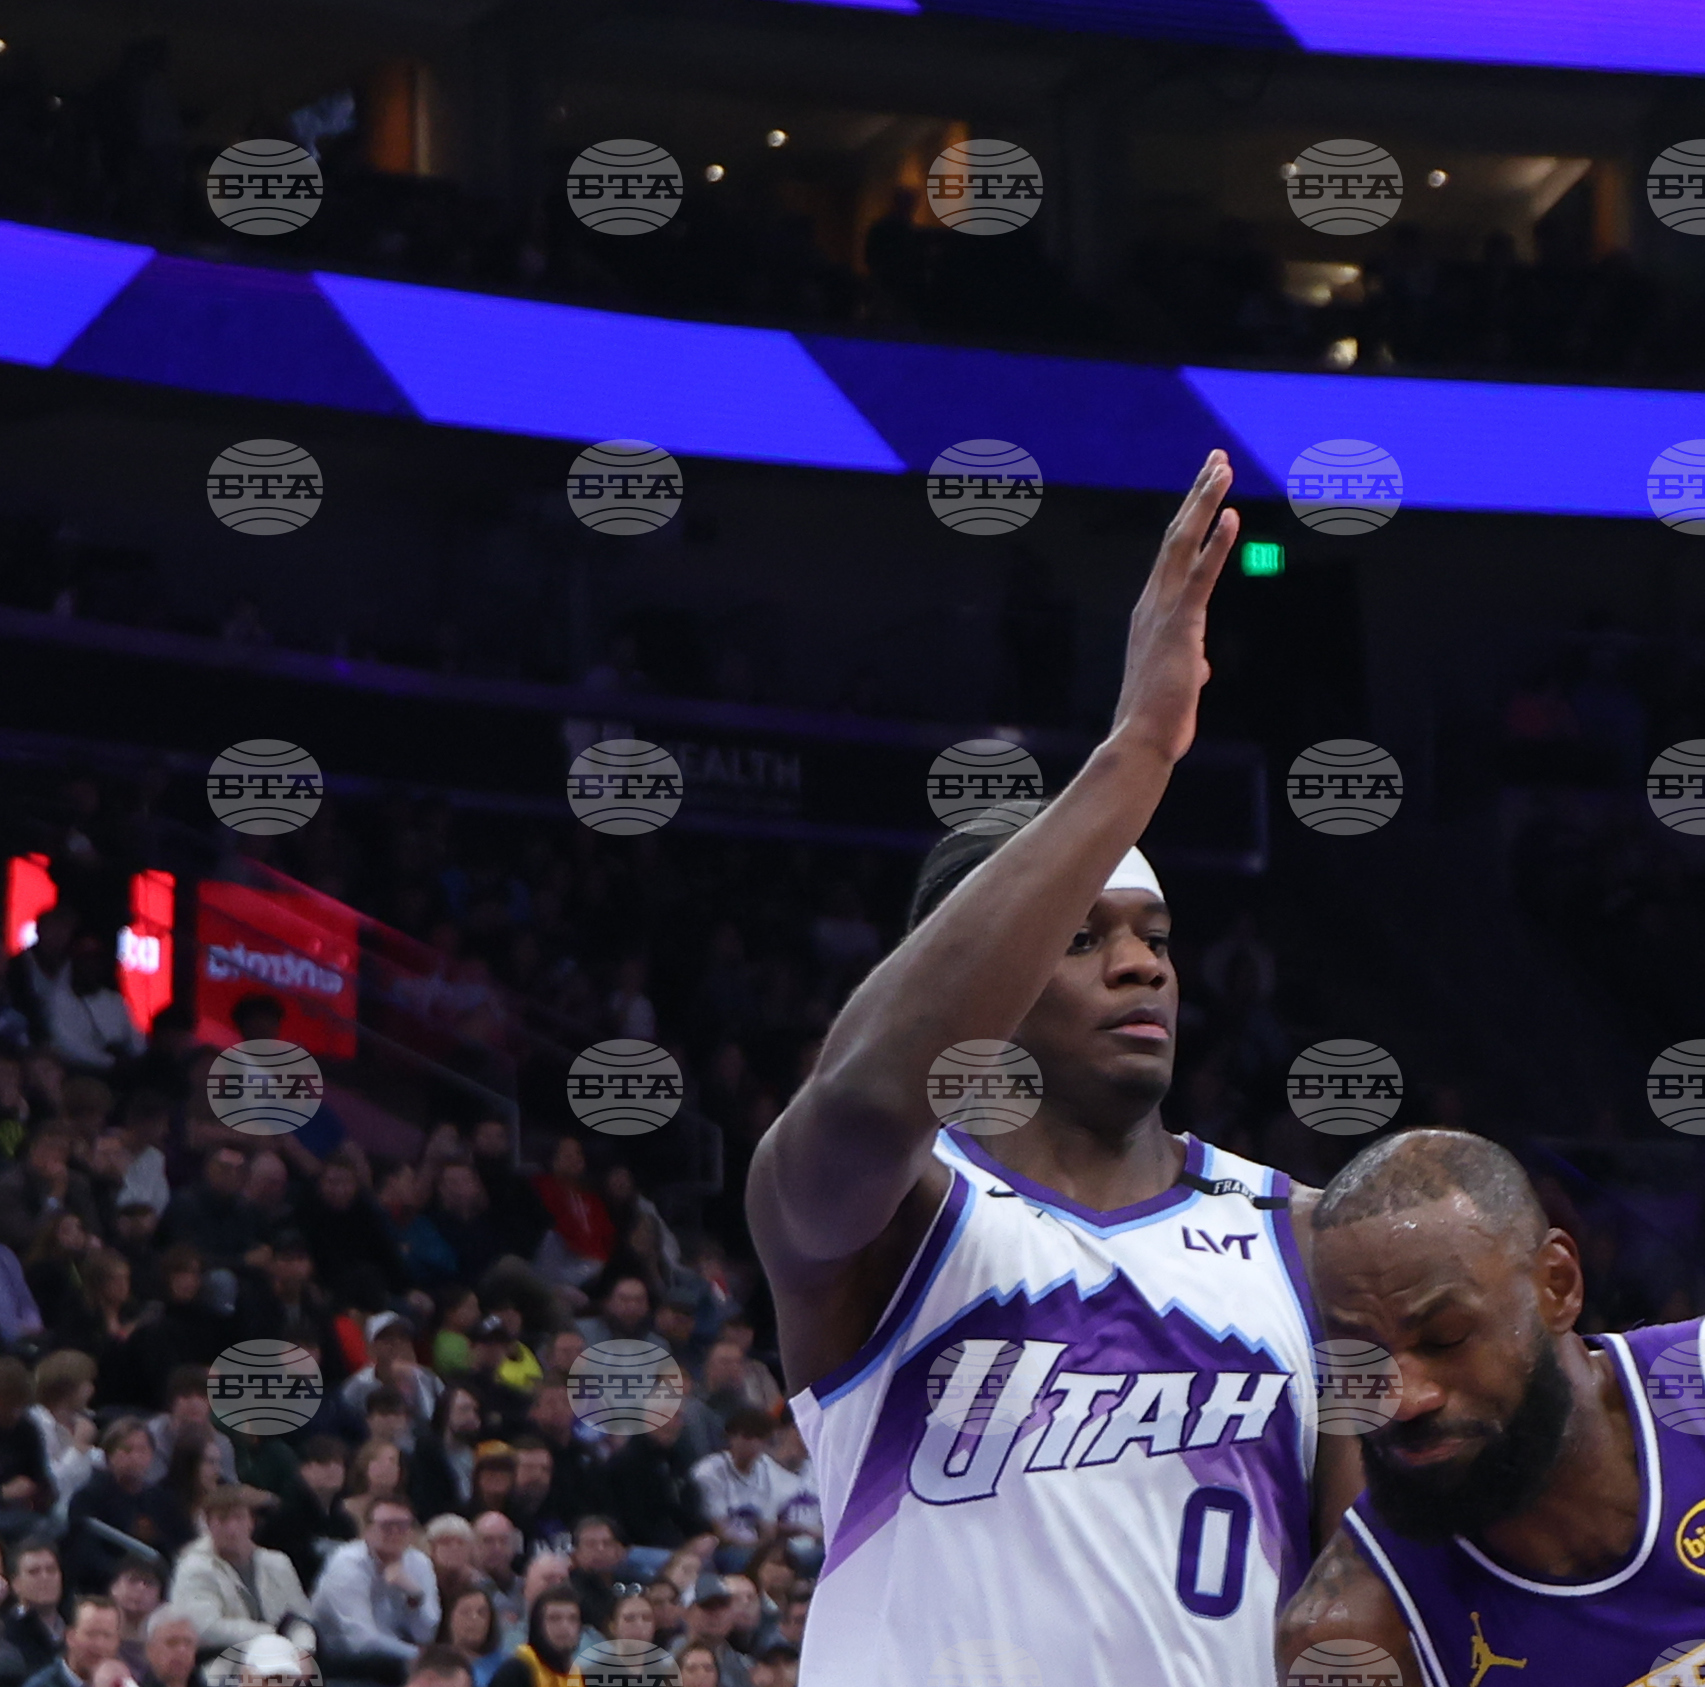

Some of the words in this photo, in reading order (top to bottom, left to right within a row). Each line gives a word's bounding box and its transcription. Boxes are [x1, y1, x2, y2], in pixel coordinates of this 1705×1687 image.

[1181, 1225, 1259, 1260] LVT
[909, 1338, 1296, 1506] UTAH
[1175, 1486, 1253, 1620] 0
